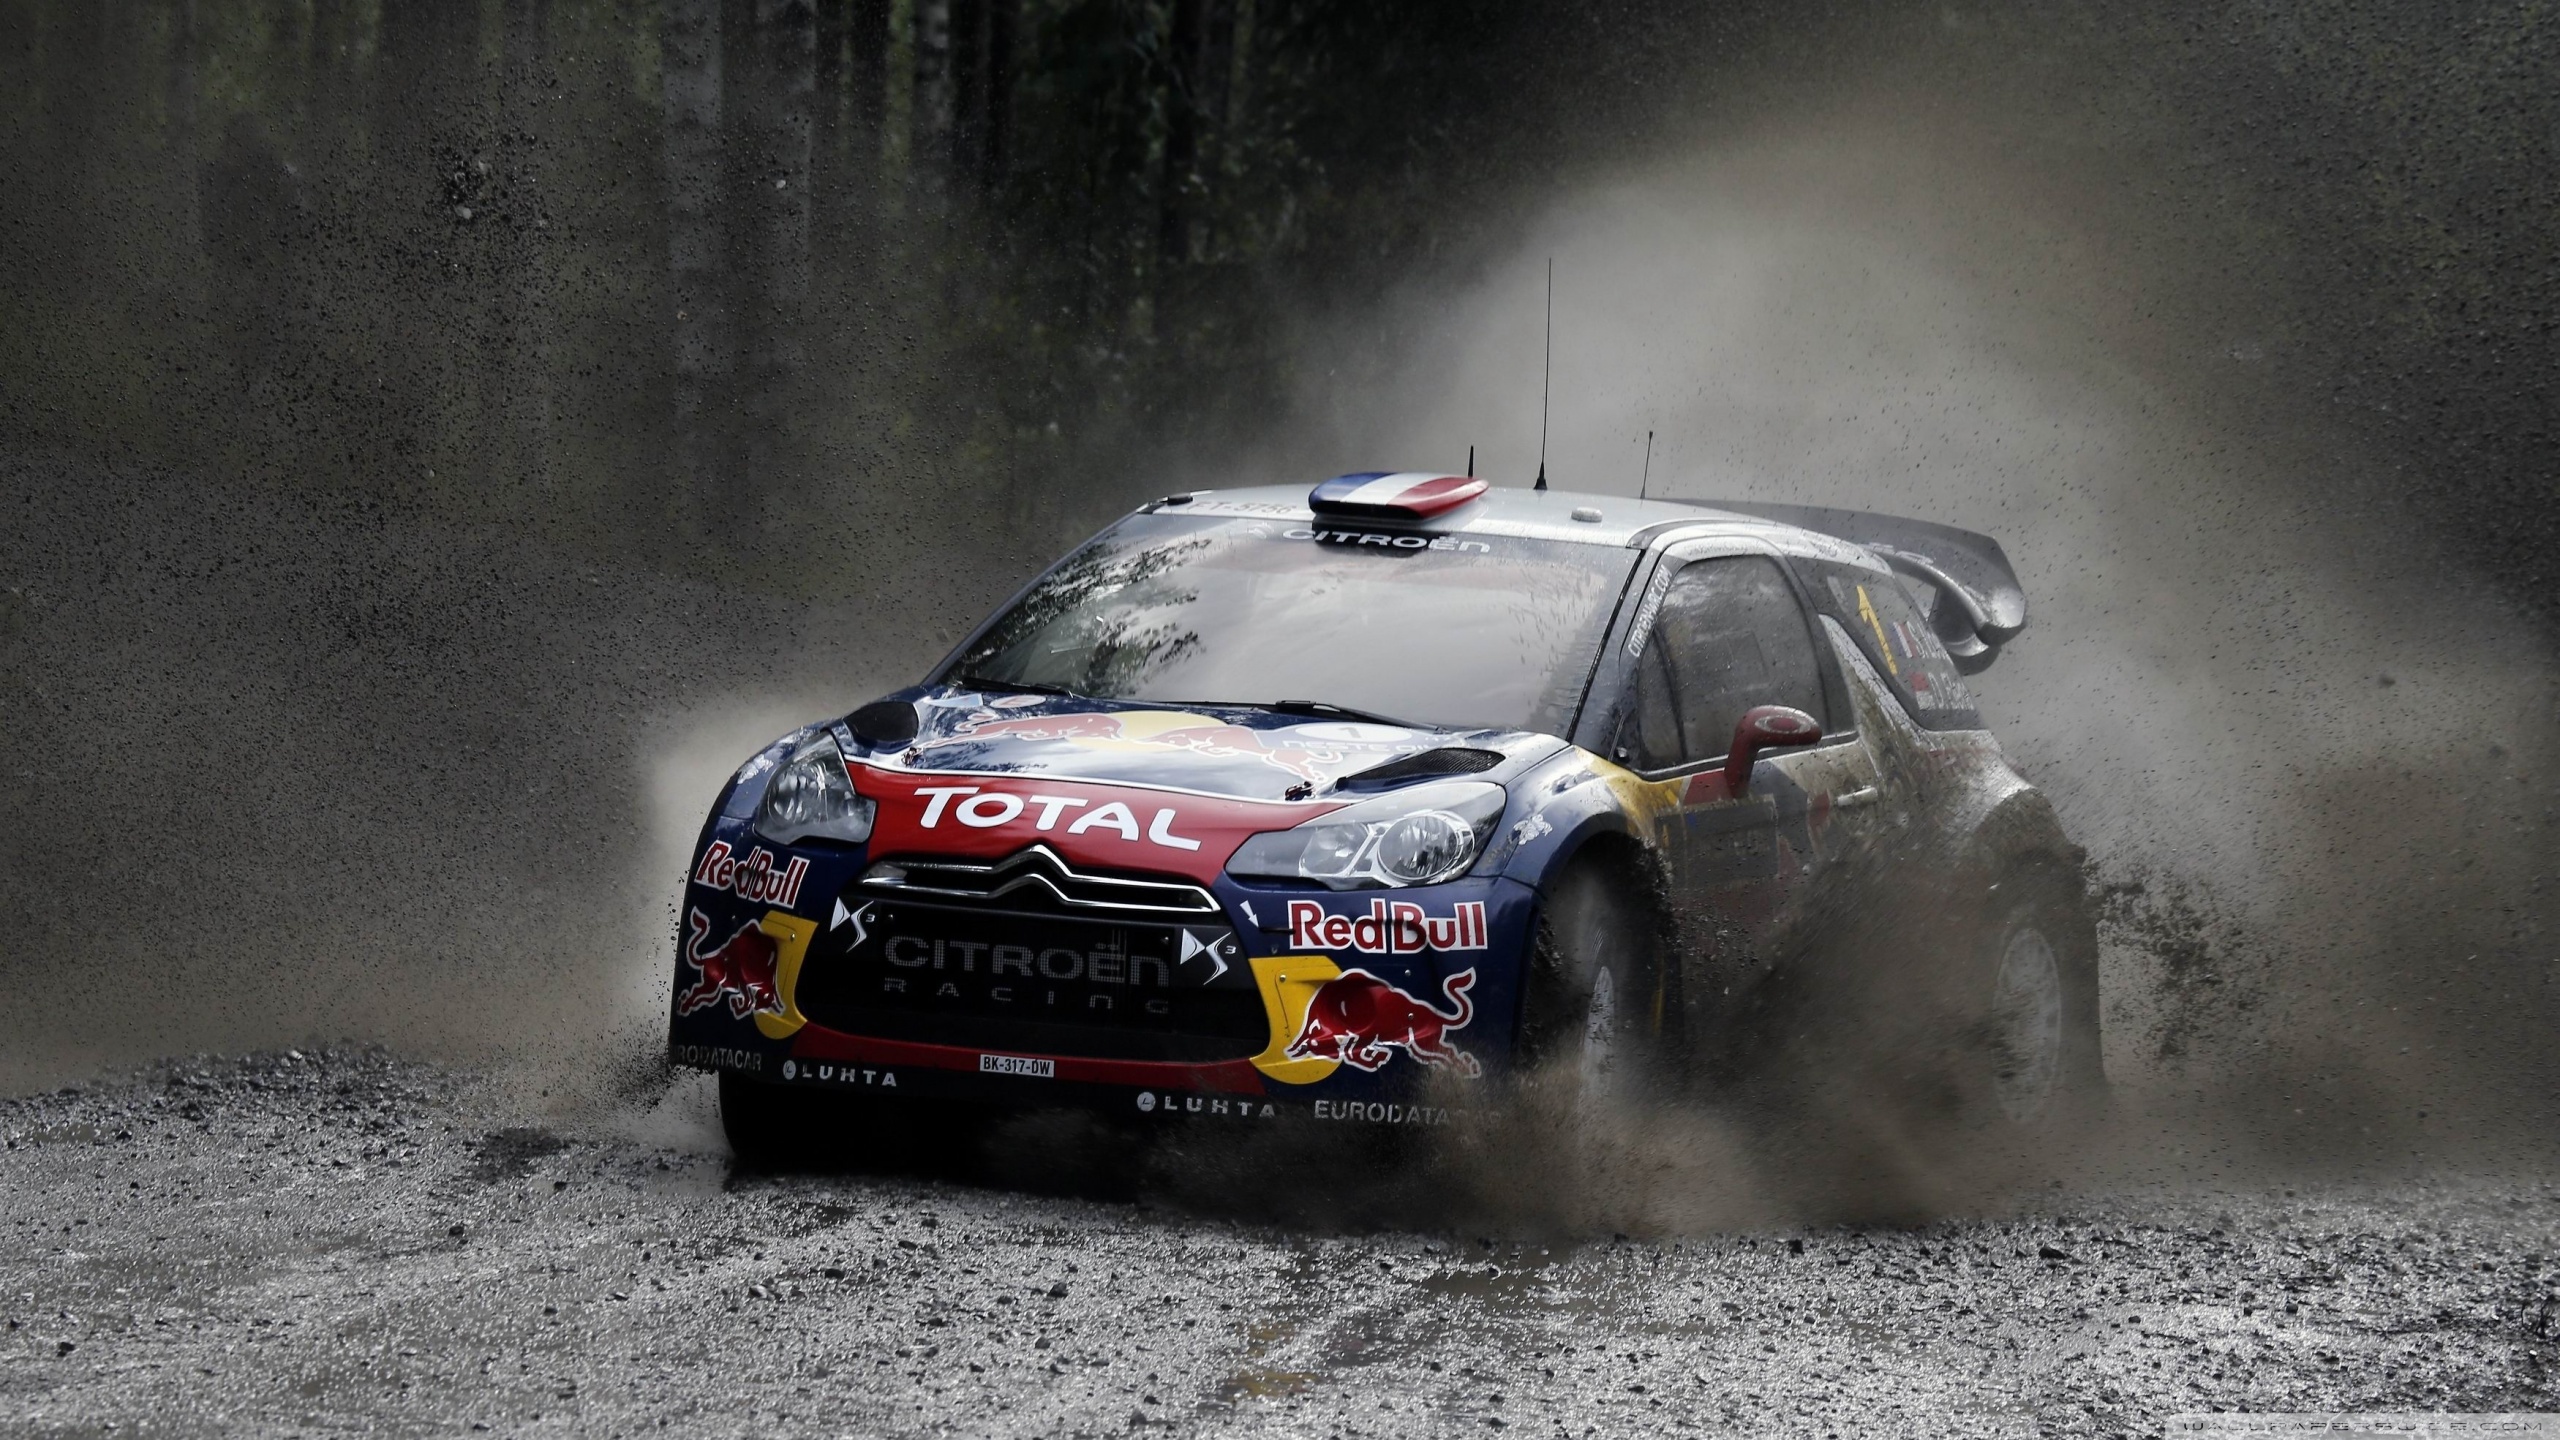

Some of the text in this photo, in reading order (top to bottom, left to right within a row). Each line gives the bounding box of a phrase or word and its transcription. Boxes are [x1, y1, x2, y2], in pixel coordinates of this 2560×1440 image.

[913, 786, 1202, 852] TOTAL
[802, 1063, 898, 1088] LUHTA
[983, 1056, 1051, 1076] BK-317-DW
[1163, 1095, 1276, 1119] LUHTA
